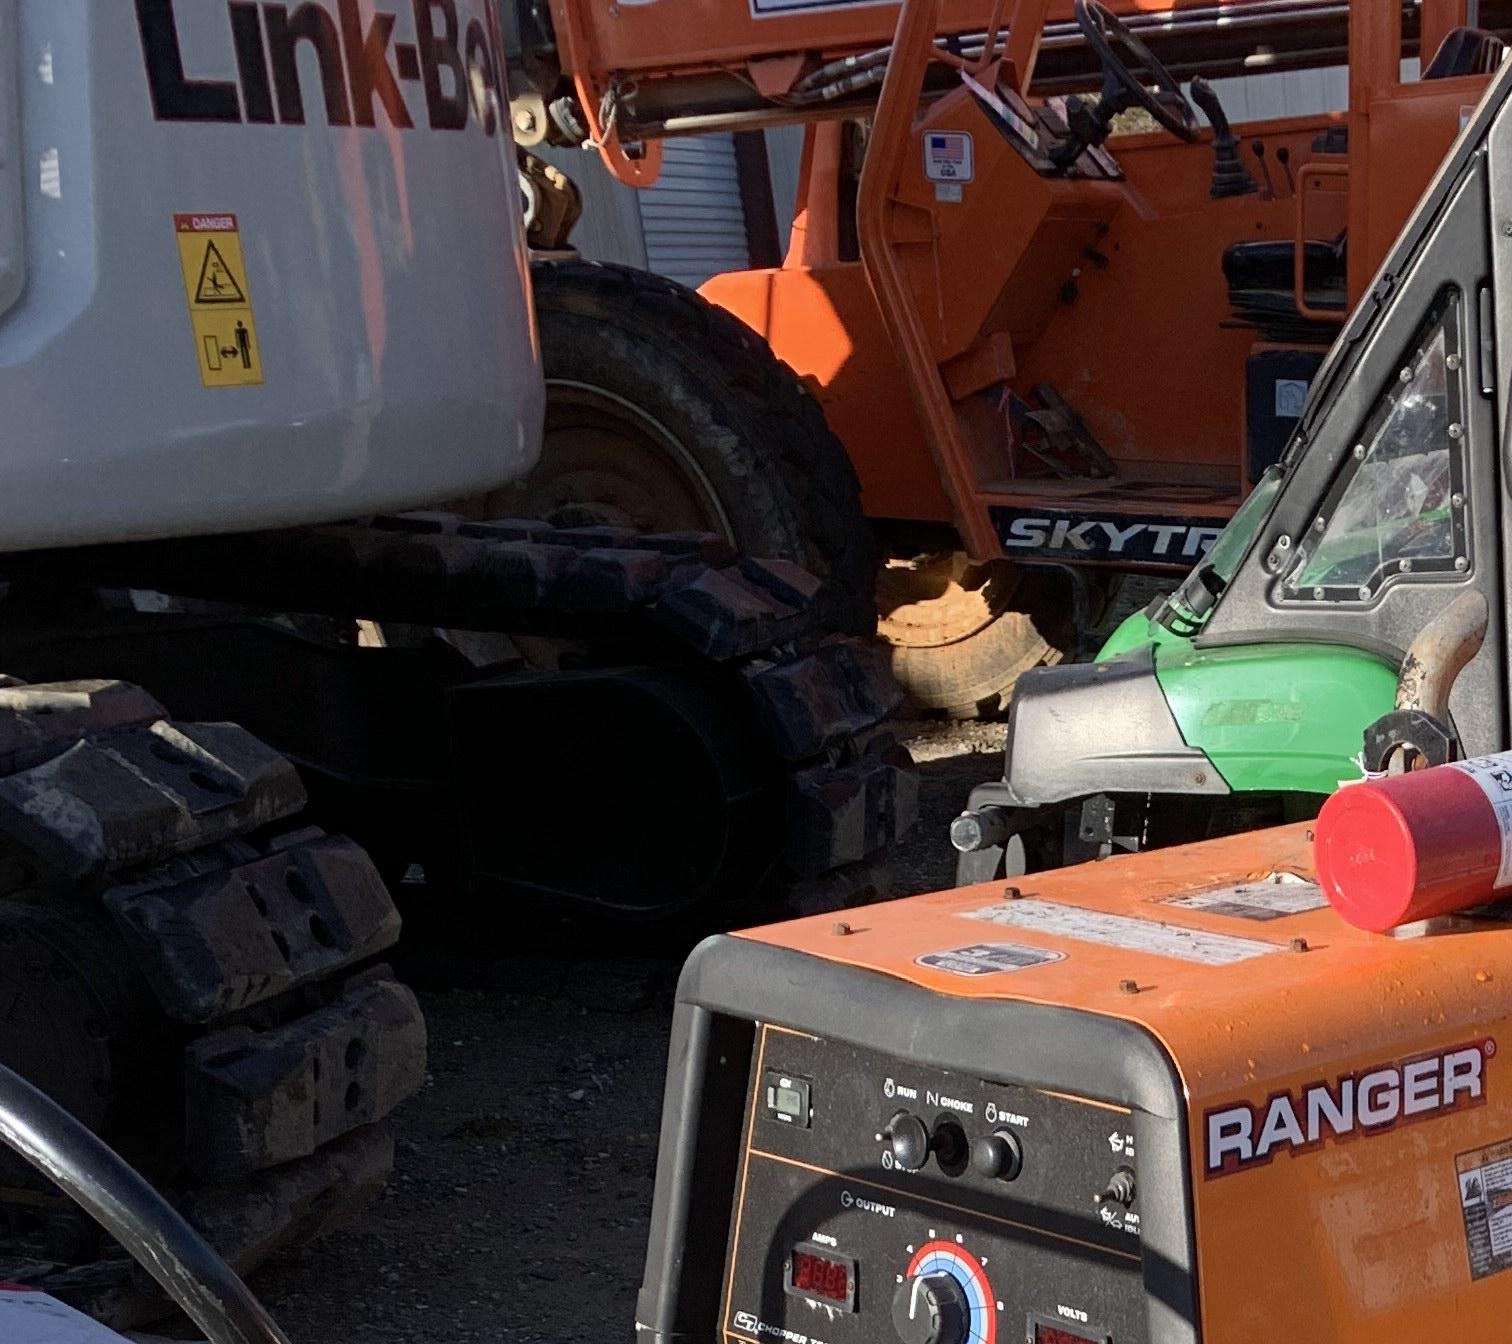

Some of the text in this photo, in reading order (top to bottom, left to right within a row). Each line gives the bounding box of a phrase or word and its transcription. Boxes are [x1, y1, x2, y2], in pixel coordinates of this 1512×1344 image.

[191, 216, 235, 231] DANGER
[897, 1086, 917, 1099] RUN
[940, 1097, 973, 1113] CHOKE
[999, 1111, 1029, 1127] START
[855, 1198, 895, 1217] OUTPUT
[812, 1232, 837, 1247] AMPS
[980, 1256, 988, 1266] 7
[1057, 1304, 1088, 1322] VOLTS
[758, 1322, 806, 1344] CHOPPER
